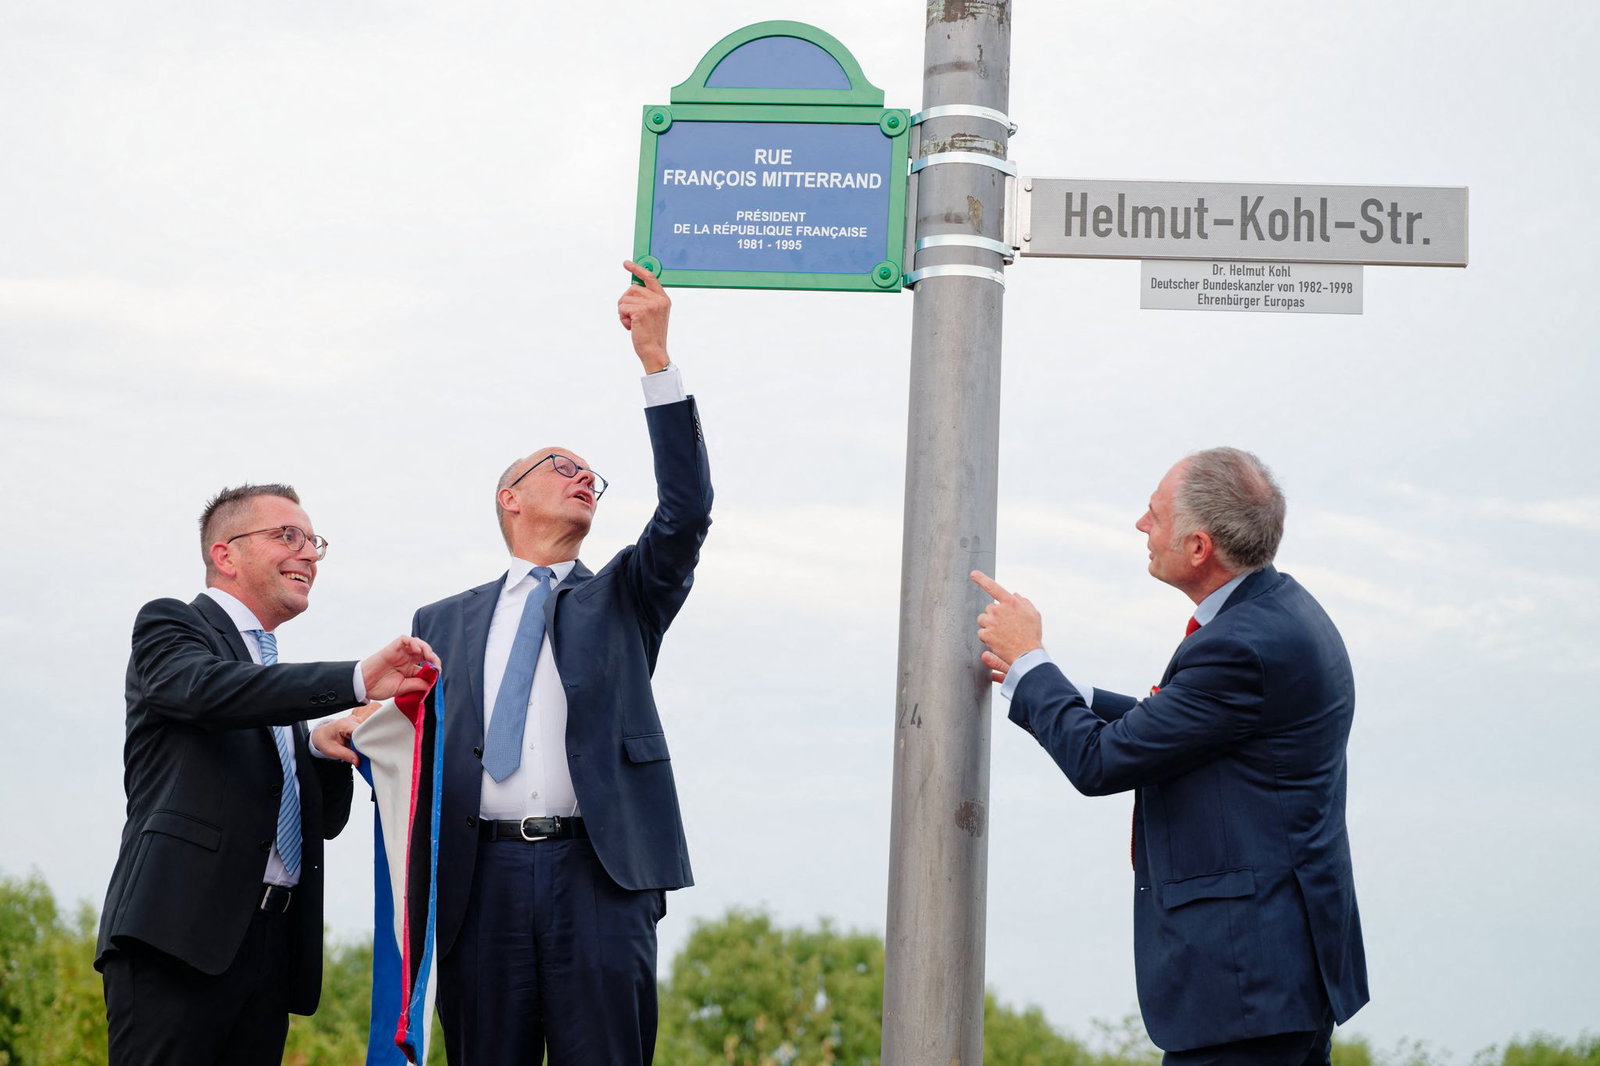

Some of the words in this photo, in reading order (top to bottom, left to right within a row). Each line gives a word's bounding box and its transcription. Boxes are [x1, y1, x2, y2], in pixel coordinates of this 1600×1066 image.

[754, 148, 793, 165] RUE
[662, 169, 757, 190] FRANÇOIS
[762, 171, 882, 189] MITTERRAND
[736, 209, 807, 223] PRÉSIDENT
[1064, 192, 1431, 246] Helmut-Kohl-Str.
[673, 223, 691, 234] DE
[693, 224, 711, 235] LA
[712, 222, 793, 238] RÉPUBLIQUE
[796, 225, 868, 240] FRANÇAISE
[737, 239, 763, 250] 1981
[776, 239, 802, 251] 1995
[1212, 264, 1226, 276] Dr.
[1229, 264, 1265, 277] Helmut
[1269, 265, 1291, 278] Kohl
[1150, 278, 1200, 291] Deutscher
[1203, 279, 1274, 293] Bundeskanzler
[1277, 284, 1295, 294] von
[1299, 281, 1353, 295] 1982-1998
[1197, 293, 1260, 309] Ehrenbürger
[1264, 295, 1305, 310] Europas
